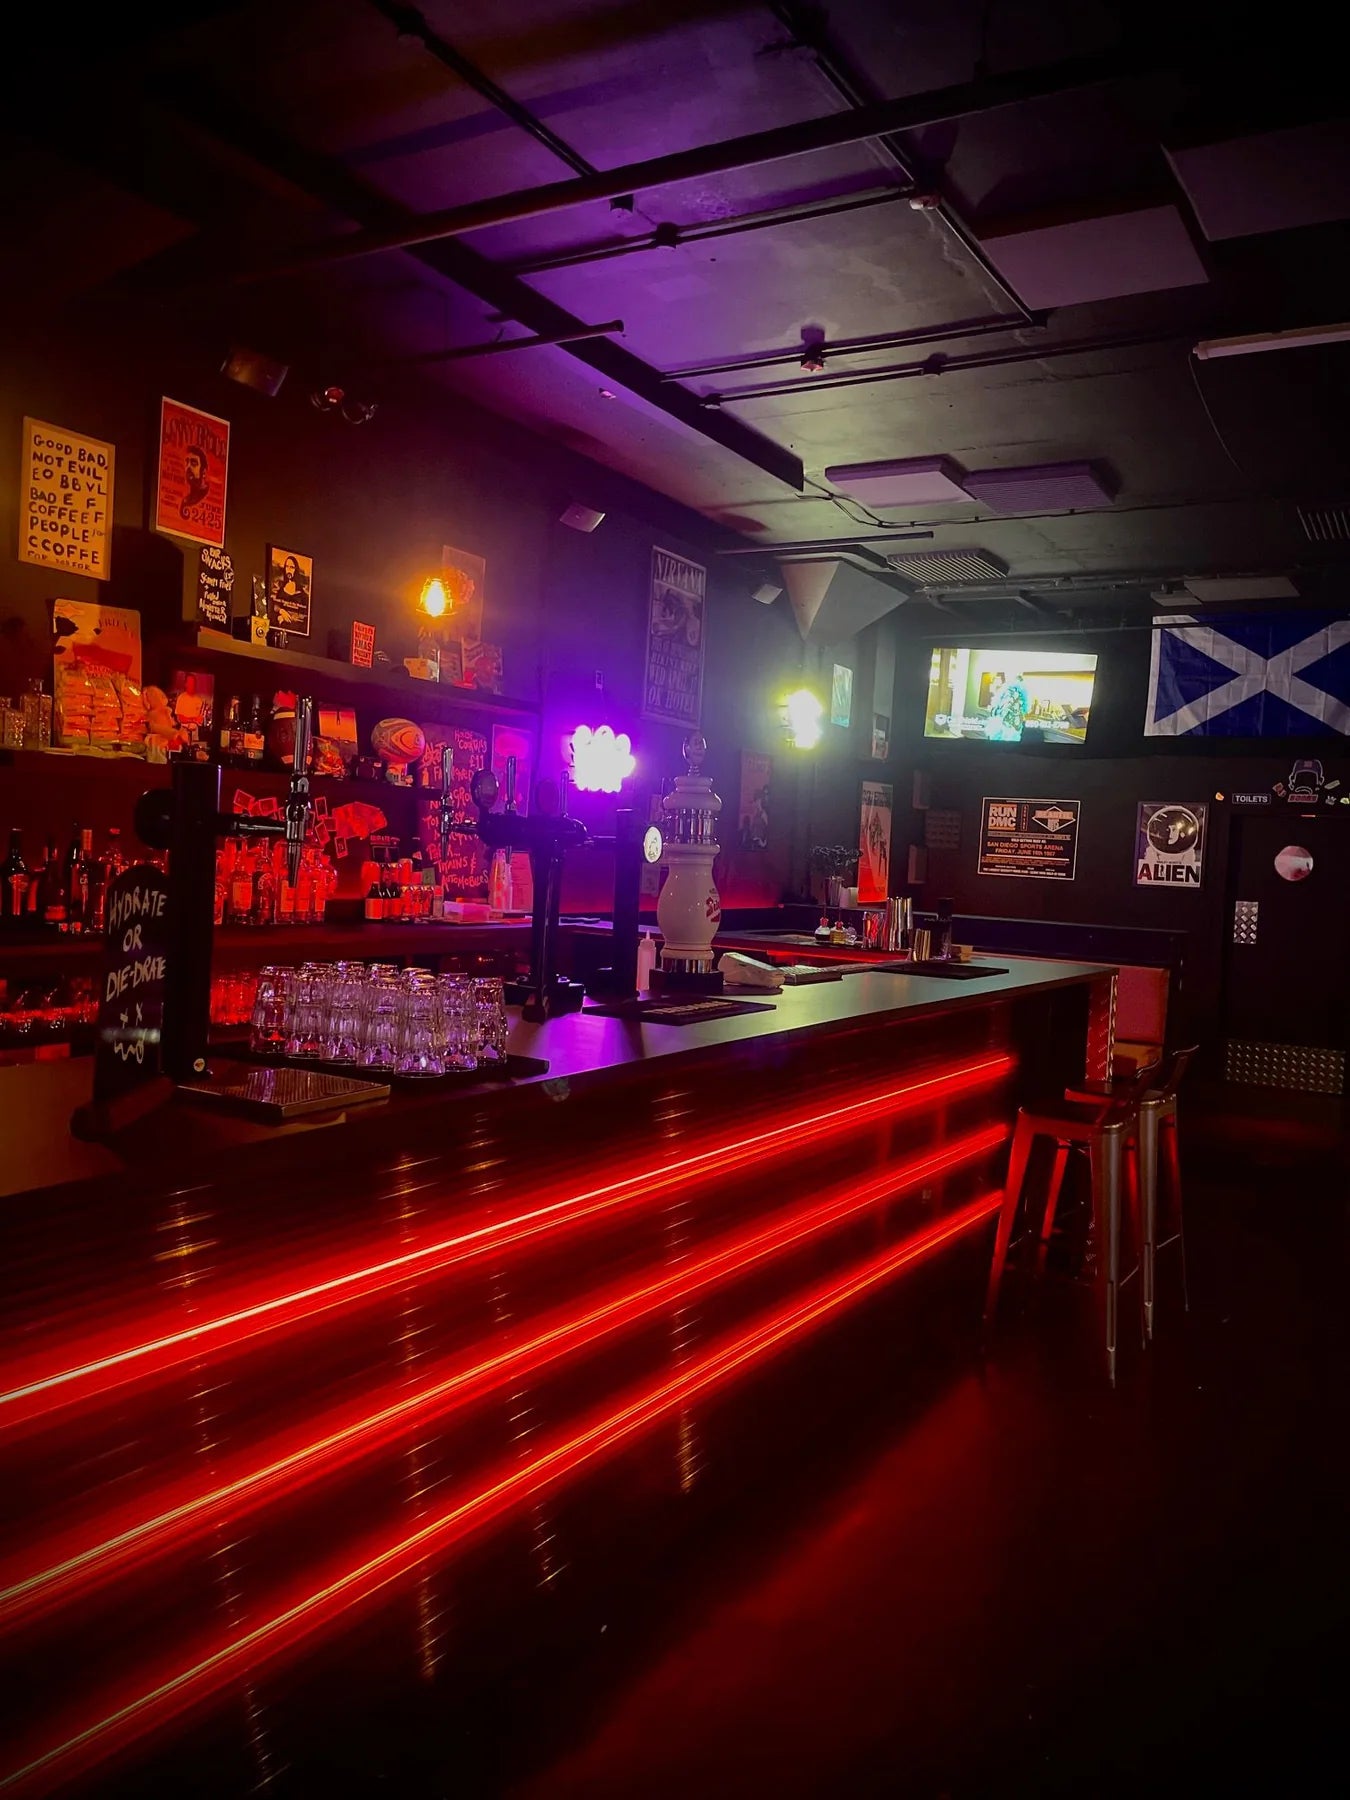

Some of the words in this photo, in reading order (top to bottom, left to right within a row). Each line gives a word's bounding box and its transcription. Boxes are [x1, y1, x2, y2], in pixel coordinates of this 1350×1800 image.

[33, 451, 64, 467] NOT
[69, 461, 102, 480] EVIL
[34, 435, 72, 455] GOOD
[78, 448, 108, 470] BAD,
[30, 487, 56, 504] BAD
[30, 516, 89, 543] PEOPLE
[988, 817, 1016, 828] DMC
[990, 807, 1017, 818] RUN
[434, 856, 468, 874] TRAINS
[1138, 863, 1201, 883] ALIEN
[109, 886, 168, 935] HYDRATE
[122, 924, 142, 952] OR
[106, 956, 166, 1002] DIE-DRATE
